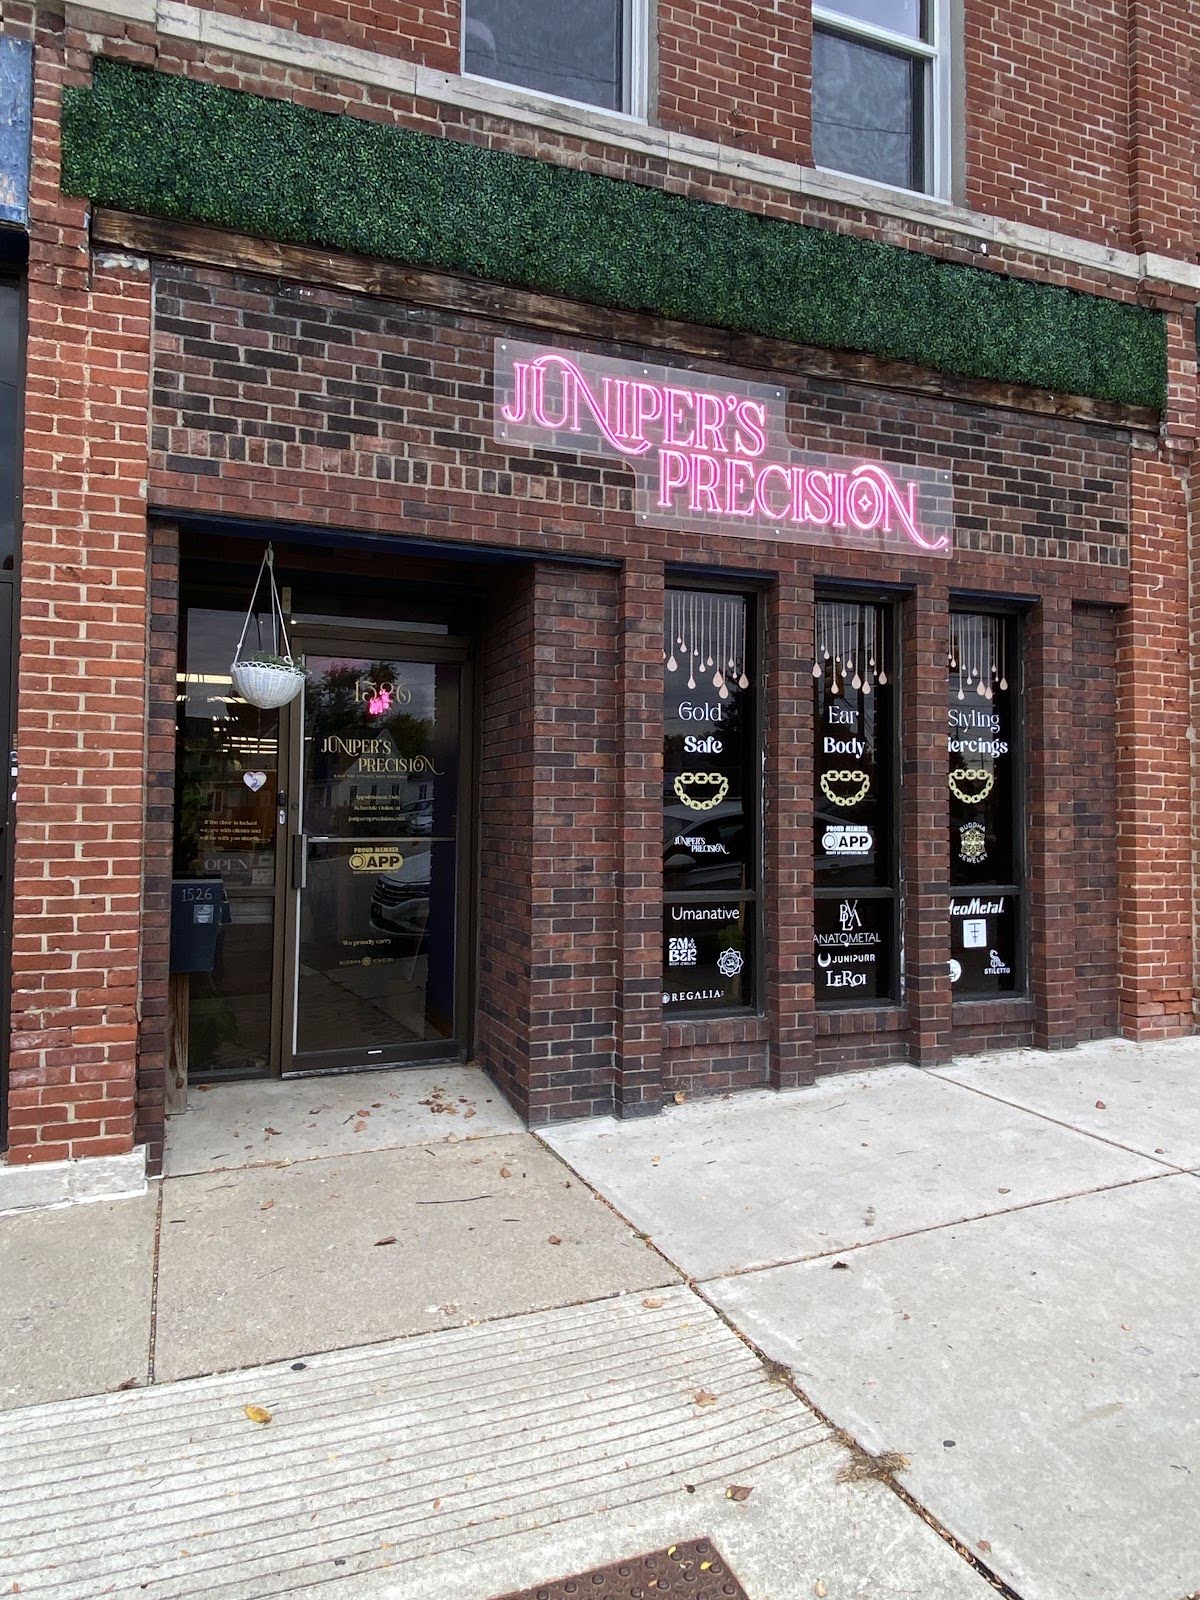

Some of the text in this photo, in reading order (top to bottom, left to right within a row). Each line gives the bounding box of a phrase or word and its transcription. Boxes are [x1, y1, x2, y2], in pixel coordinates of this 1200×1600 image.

[501, 354, 767, 457] JUNIPER'S
[657, 447, 950, 551] PRECISION
[678, 701, 1000, 733] Gold Ear Styling
[320, 735, 392, 757] JUNIPER'S
[683, 735, 1009, 759] Safe Body iercings
[358, 755, 445, 776] PRECISION
[958, 821, 986, 834] BUDDHA
[673, 835, 706, 847] JUNIPER'S
[838, 836, 869, 848] APP
[690, 843, 730, 855] PRECISION
[204, 858, 248, 871] OPEN
[366, 856, 400, 868] APP
[958, 852, 988, 864] JEWELRY
[181, 887, 213, 902] 1526
[671, 905, 740, 921] Umanative
[813, 932, 882, 944] ANATOMETAL
[832, 953, 876, 964] JUNIPURR
[984, 967, 1011, 975] STILETTO
